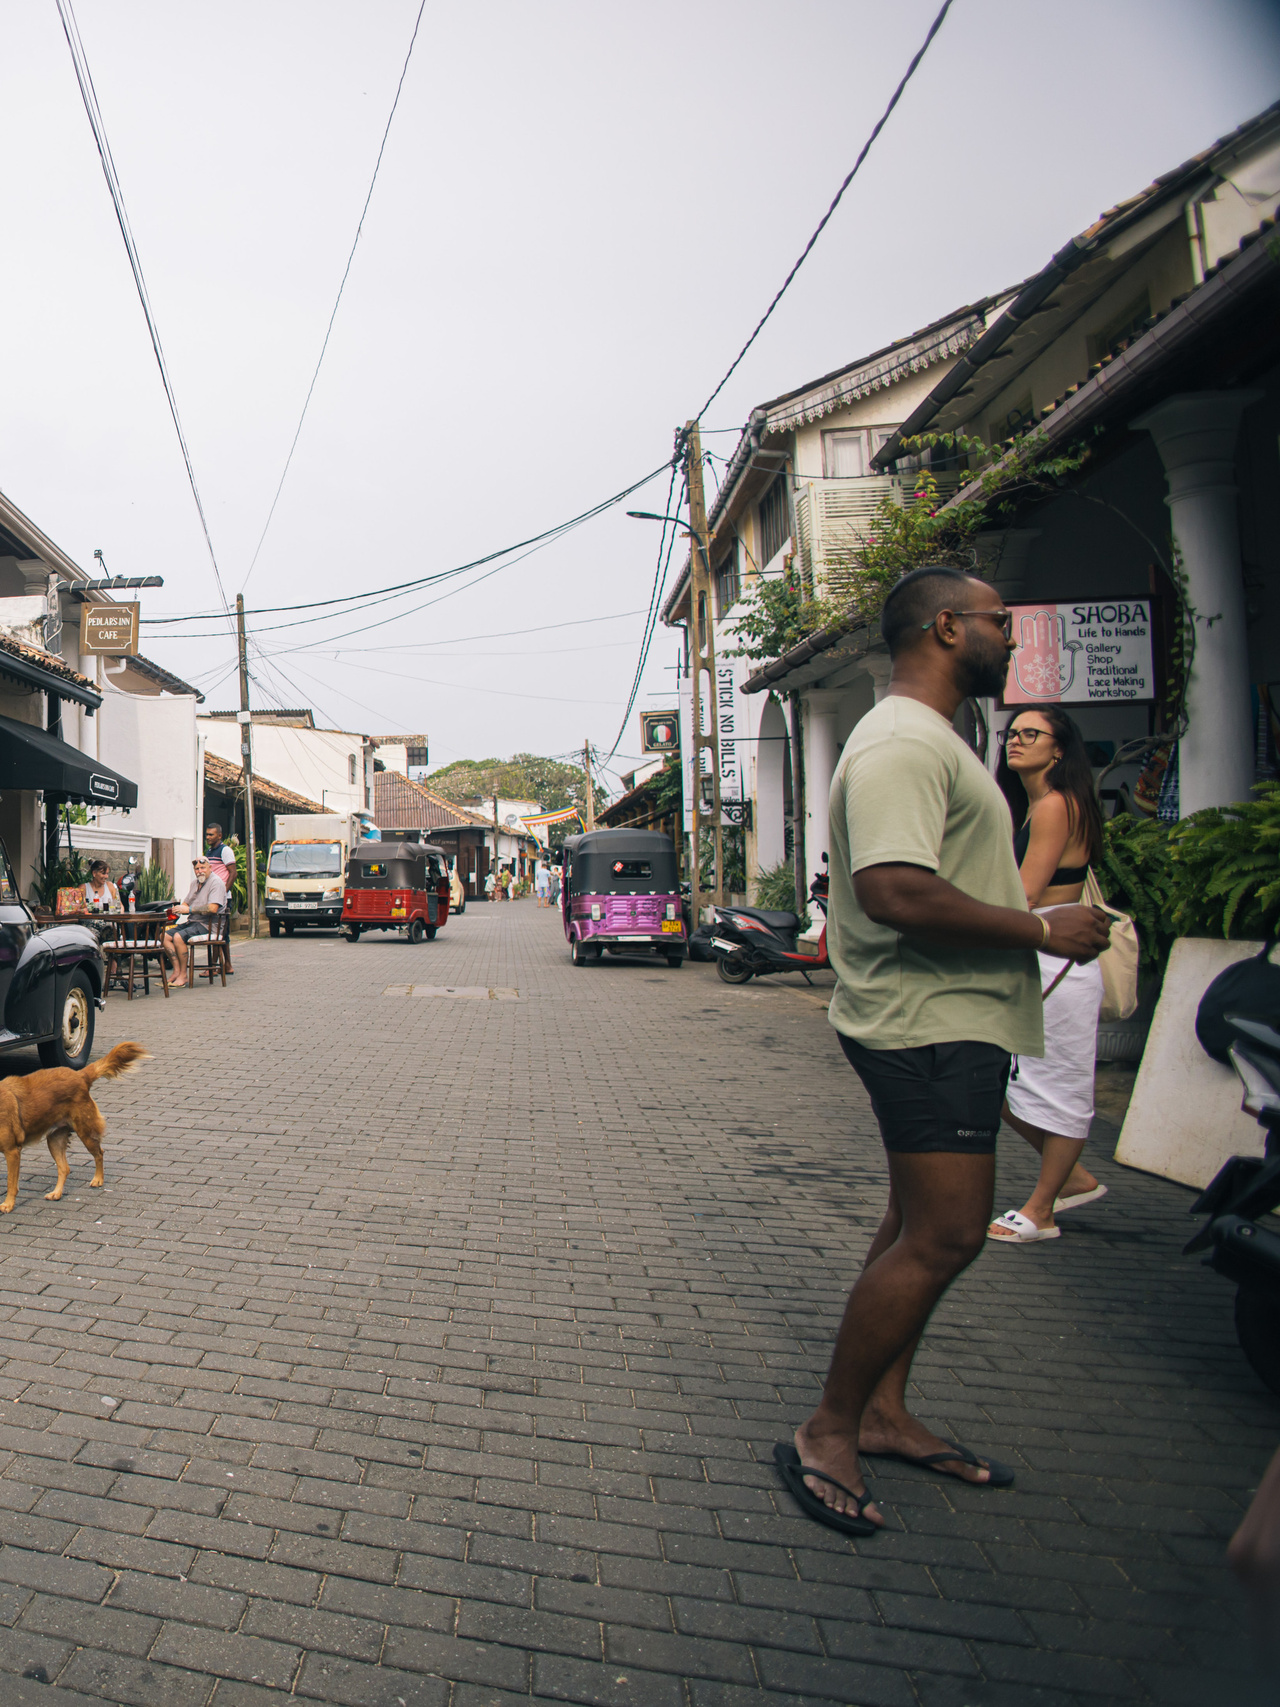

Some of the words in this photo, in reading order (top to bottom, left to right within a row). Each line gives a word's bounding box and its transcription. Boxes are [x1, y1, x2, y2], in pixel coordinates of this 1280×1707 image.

[88, 617, 118, 626] PEDLAR'S
[118, 617, 131, 626] INN
[98, 630, 118, 640] CAFE
[1078, 627, 1097, 638] Life
[1101, 627, 1112, 637] to
[1115, 626, 1146, 637] Hands
[1085, 643, 1121, 654] Gallery
[1087, 654, 1113, 665] Shop
[1086, 664, 1137, 676] Traditional
[1087, 677, 1111, 687] Lace
[1112, 677, 1145, 688] Making
[718, 669, 734, 708] STICK
[1088, 689, 1137, 698] Workshop
[719, 714, 735, 733] NO
[720, 738, 736, 778] BILLS
